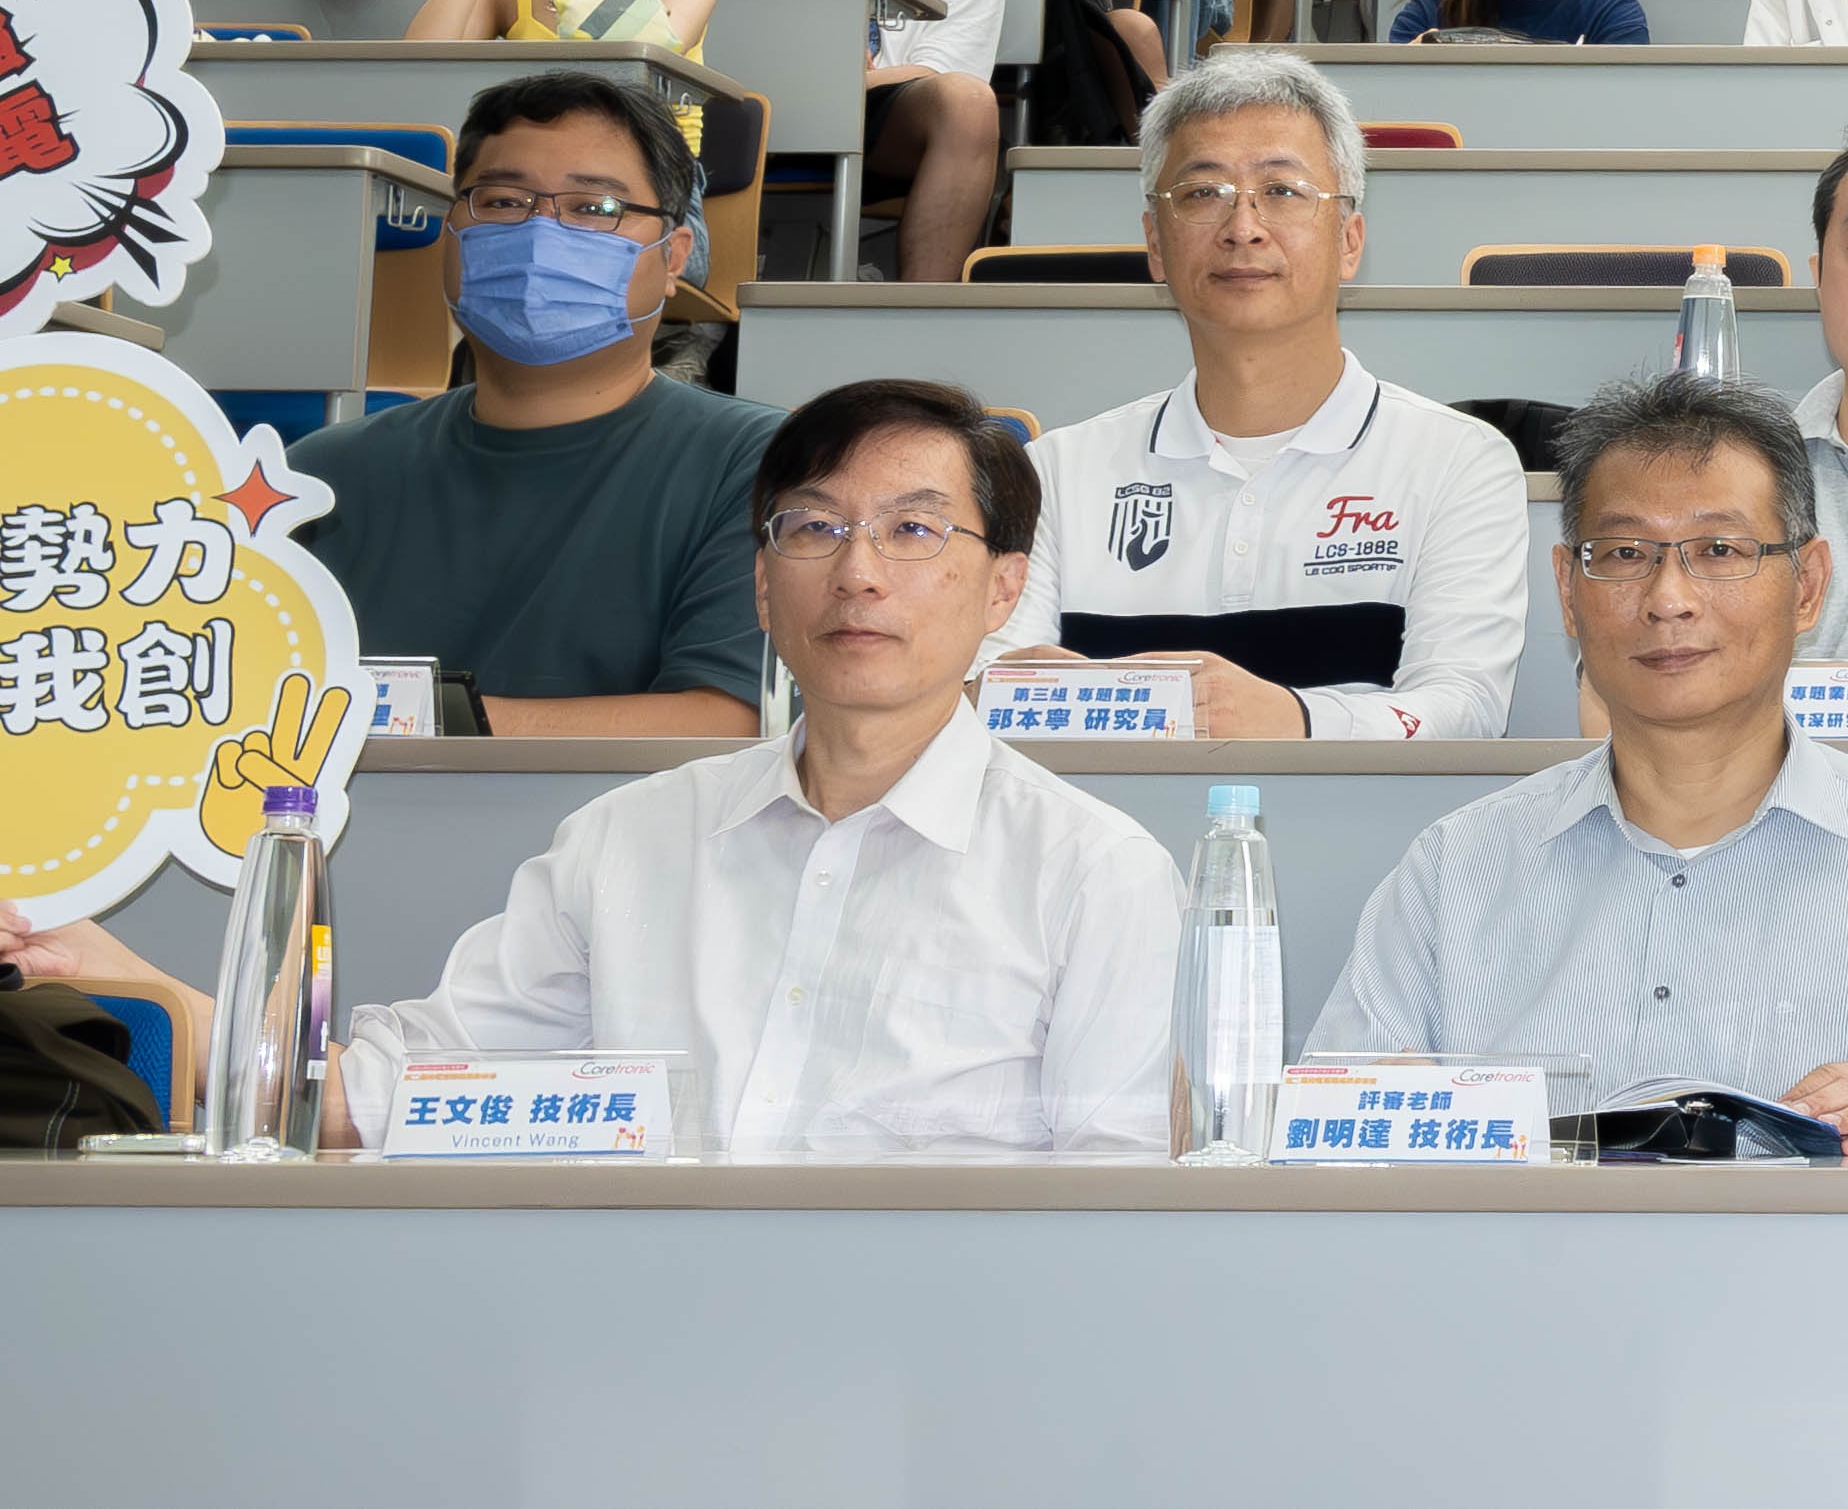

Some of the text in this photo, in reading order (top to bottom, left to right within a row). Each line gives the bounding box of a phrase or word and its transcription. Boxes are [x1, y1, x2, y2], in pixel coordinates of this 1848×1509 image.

[1315, 495, 1400, 539] Fra
[1013, 686, 1069, 703] 第三組
[1083, 707, 1168, 732] 研究員
[579, 1061, 656, 1076] Coretronic
[1458, 1068, 1536, 1084] Coretronic
[404, 1093, 638, 1126] 王文俊 技術長
[1357, 1090, 1454, 1111] 評審老師
[451, 1133, 580, 1149] Vincent Wang
[1285, 1118, 1515, 1151] 劉明達 技術長
